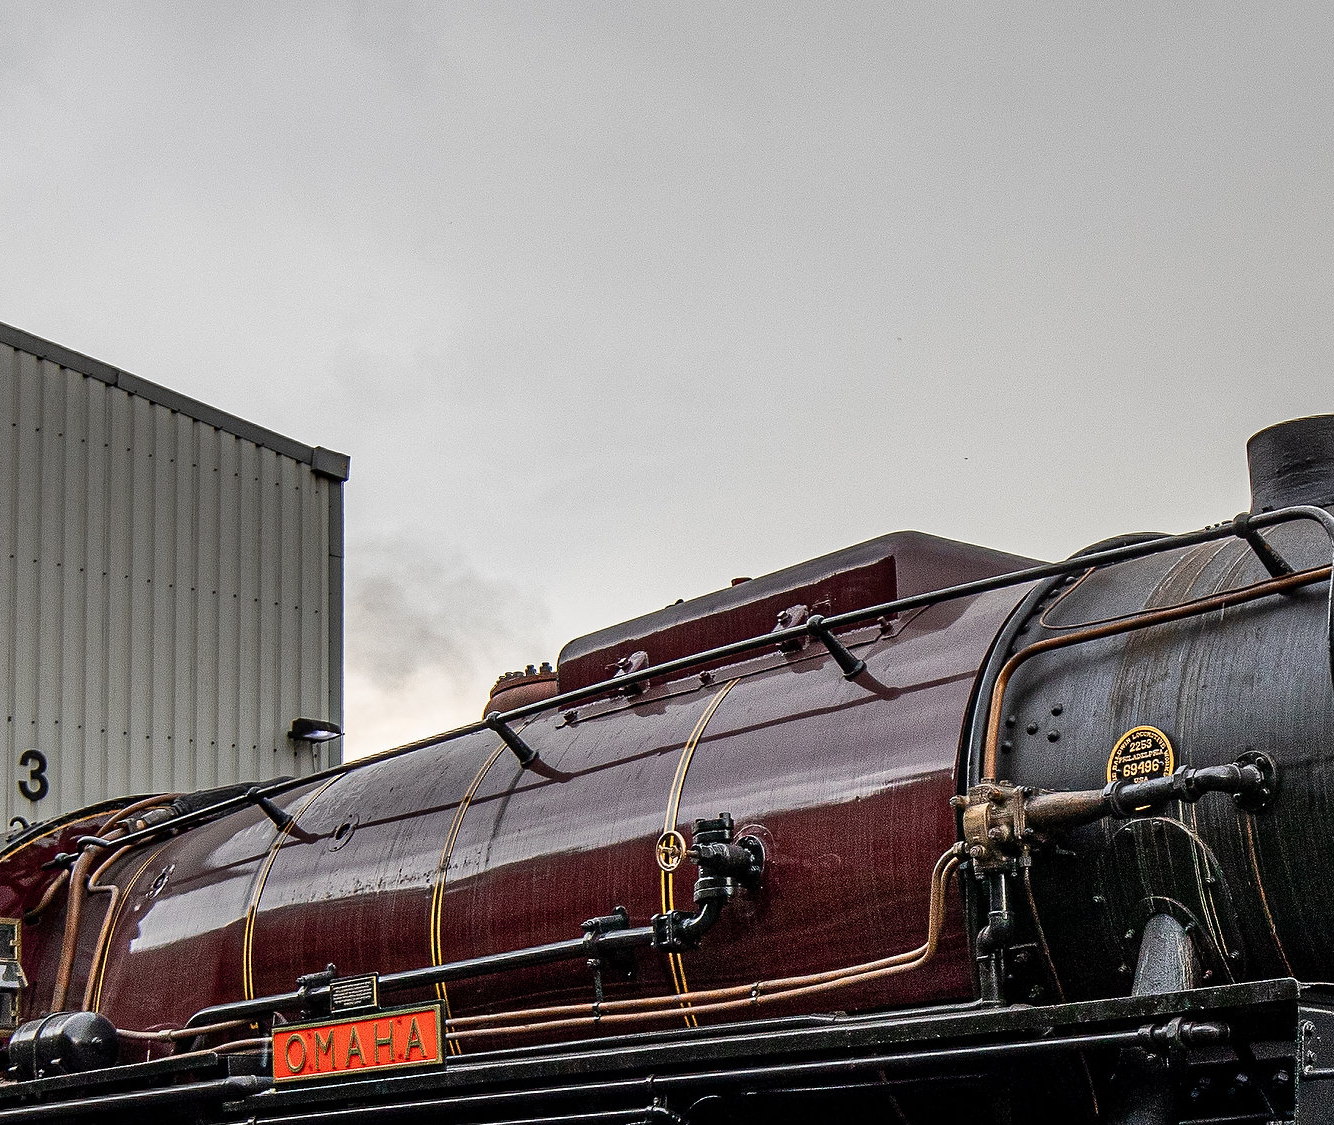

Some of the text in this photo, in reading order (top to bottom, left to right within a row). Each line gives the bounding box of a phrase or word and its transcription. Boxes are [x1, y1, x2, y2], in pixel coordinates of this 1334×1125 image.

[1129, 738, 1153, 753] 2253
[18, 748, 49, 802] 3
[1123, 758, 1160, 777] 69496
[284, 1016, 427, 1073] OMAHA
